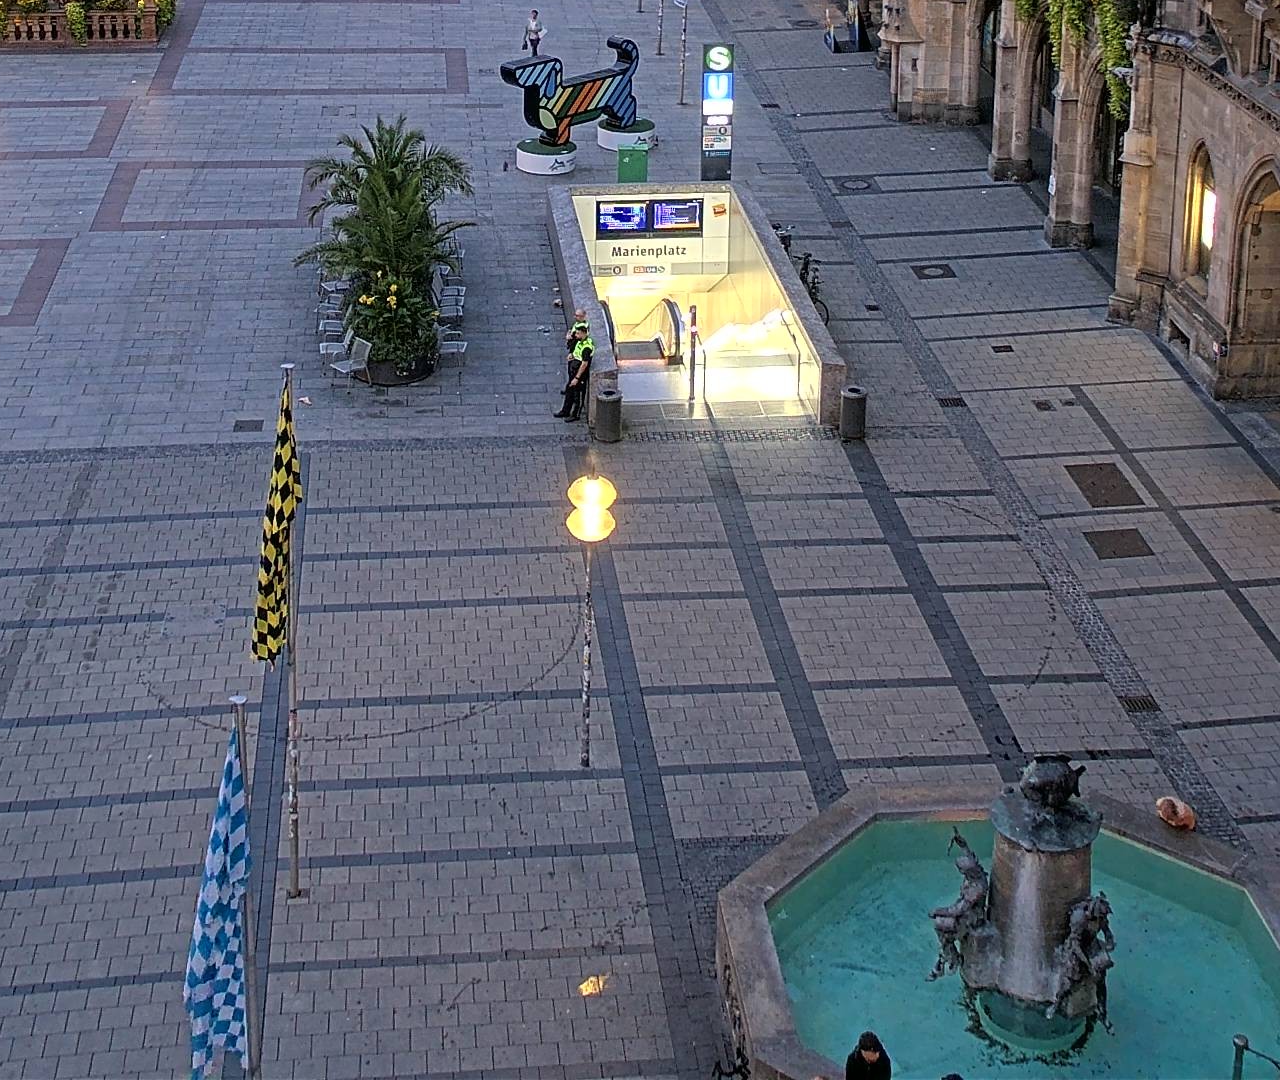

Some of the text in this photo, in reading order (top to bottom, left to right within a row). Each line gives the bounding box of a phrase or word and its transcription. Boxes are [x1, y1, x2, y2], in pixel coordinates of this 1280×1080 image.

[708, 46, 730, 71] S
[707, 75, 729, 99] U
[611, 245, 687, 259] Marienplatz
